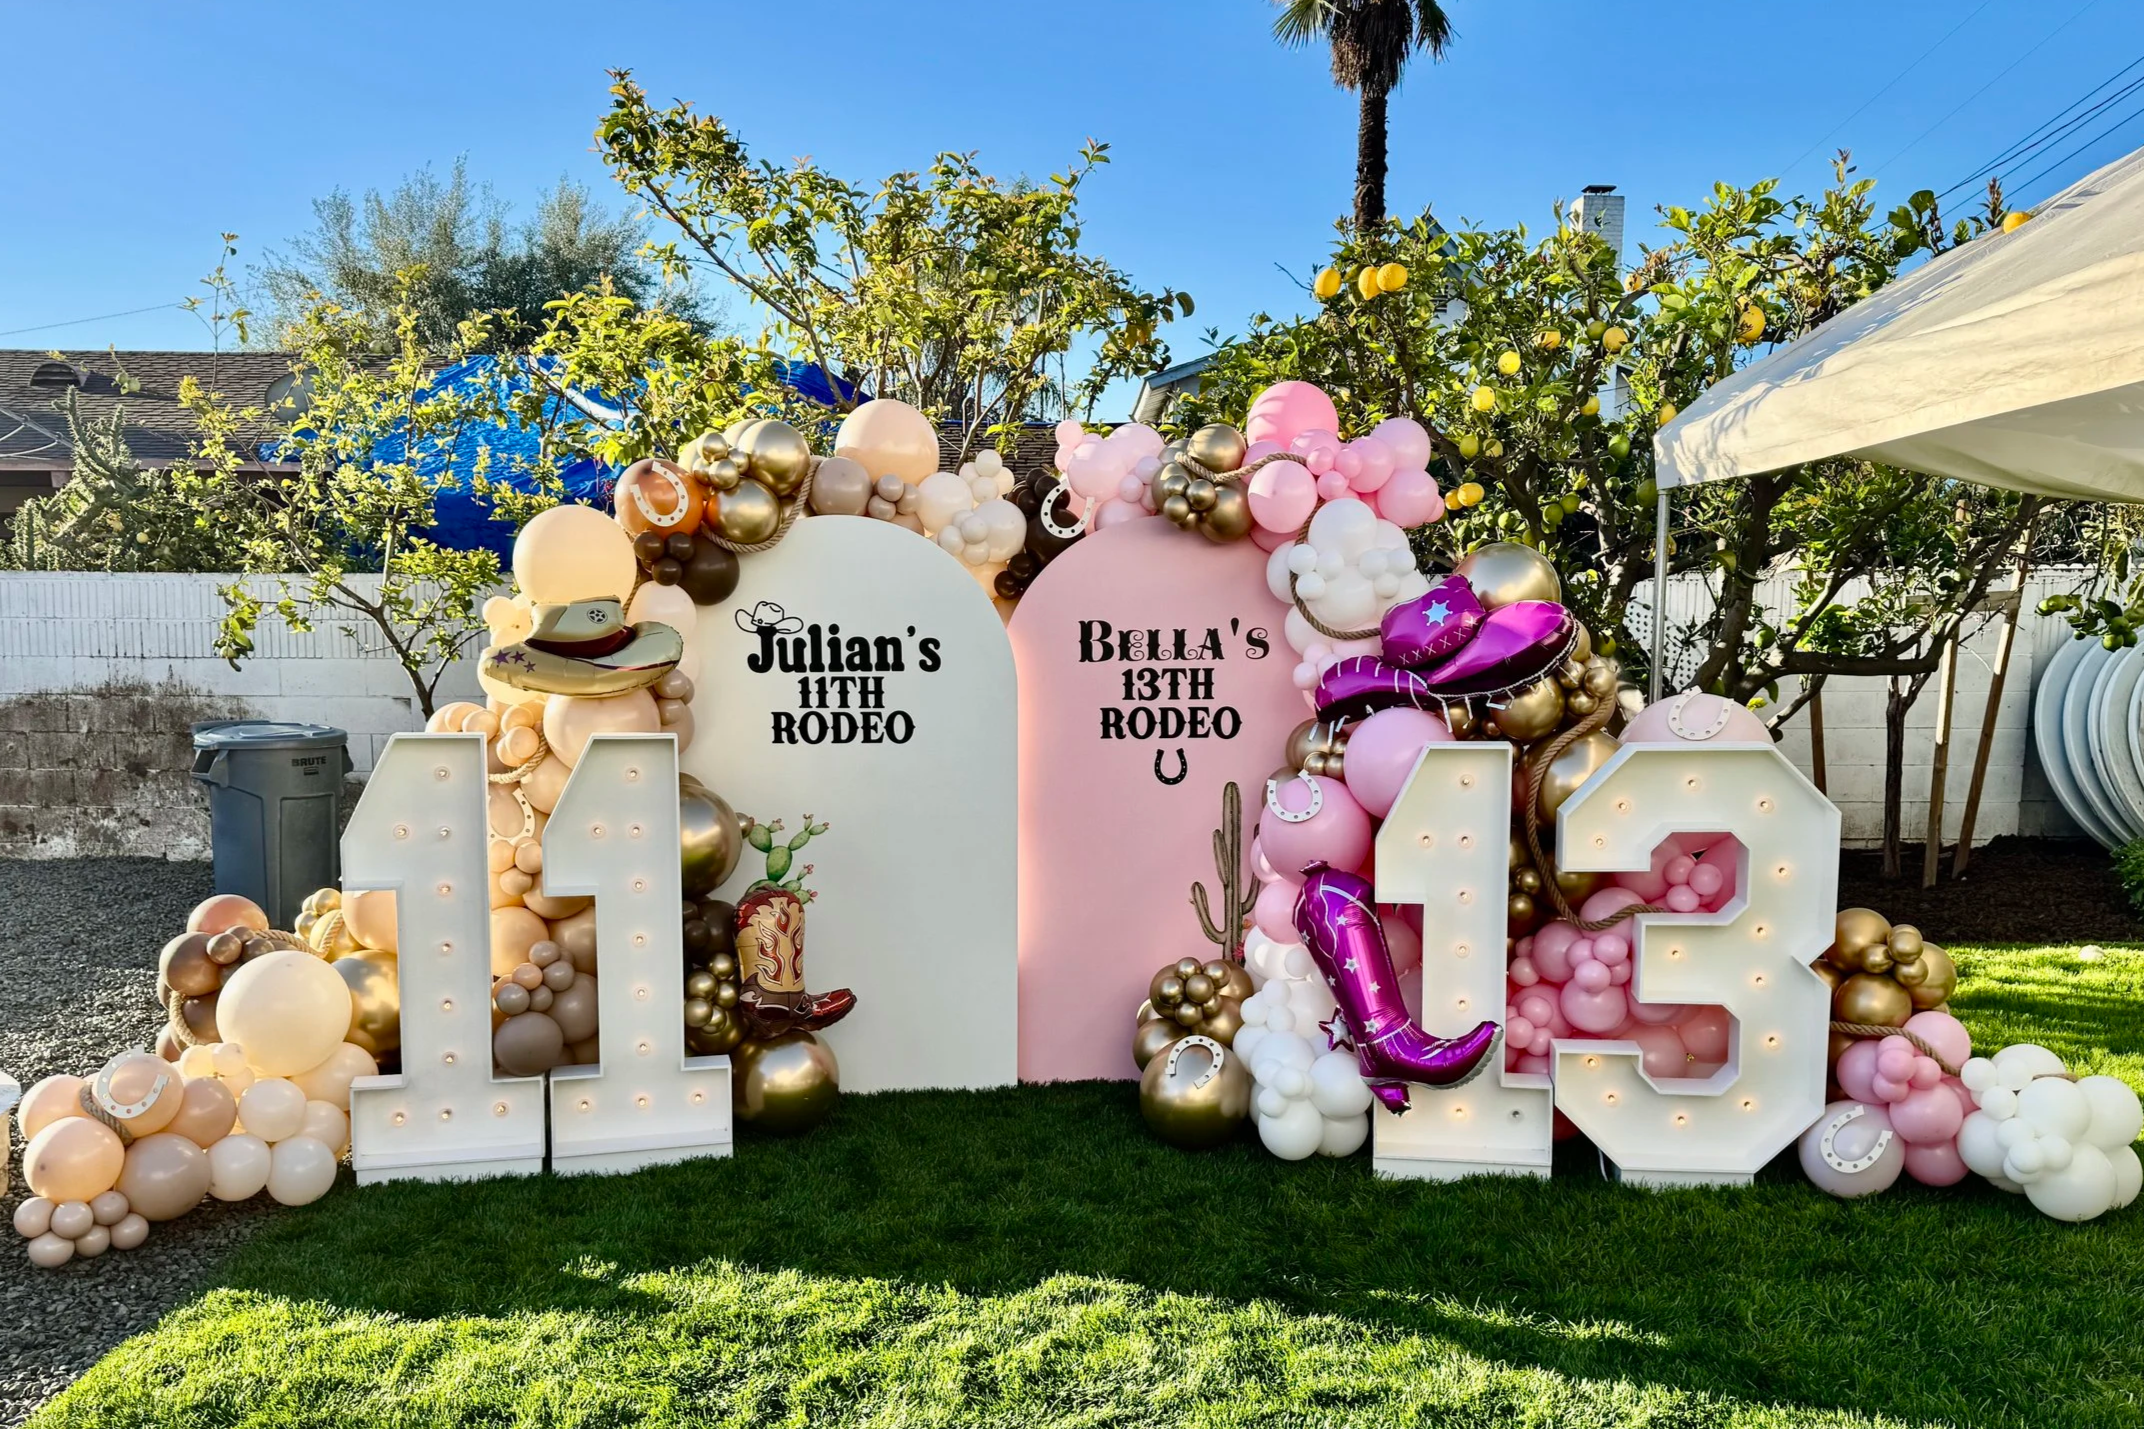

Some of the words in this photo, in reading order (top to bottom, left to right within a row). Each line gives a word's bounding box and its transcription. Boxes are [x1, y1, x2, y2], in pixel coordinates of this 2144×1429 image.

[747, 624, 942, 674] Julian's
[1078, 617, 1270, 663] BELLA'S
[797, 676, 886, 709] 11TH
[1121, 667, 1216, 701] 13TH
[770, 710, 916, 744] RODEO
[1100, 706, 1243, 740] RODEO
[291, 755, 327, 767] BRUTE
[340, 732, 734, 1184] 11
[1373, 741, 1842, 1181] 13
